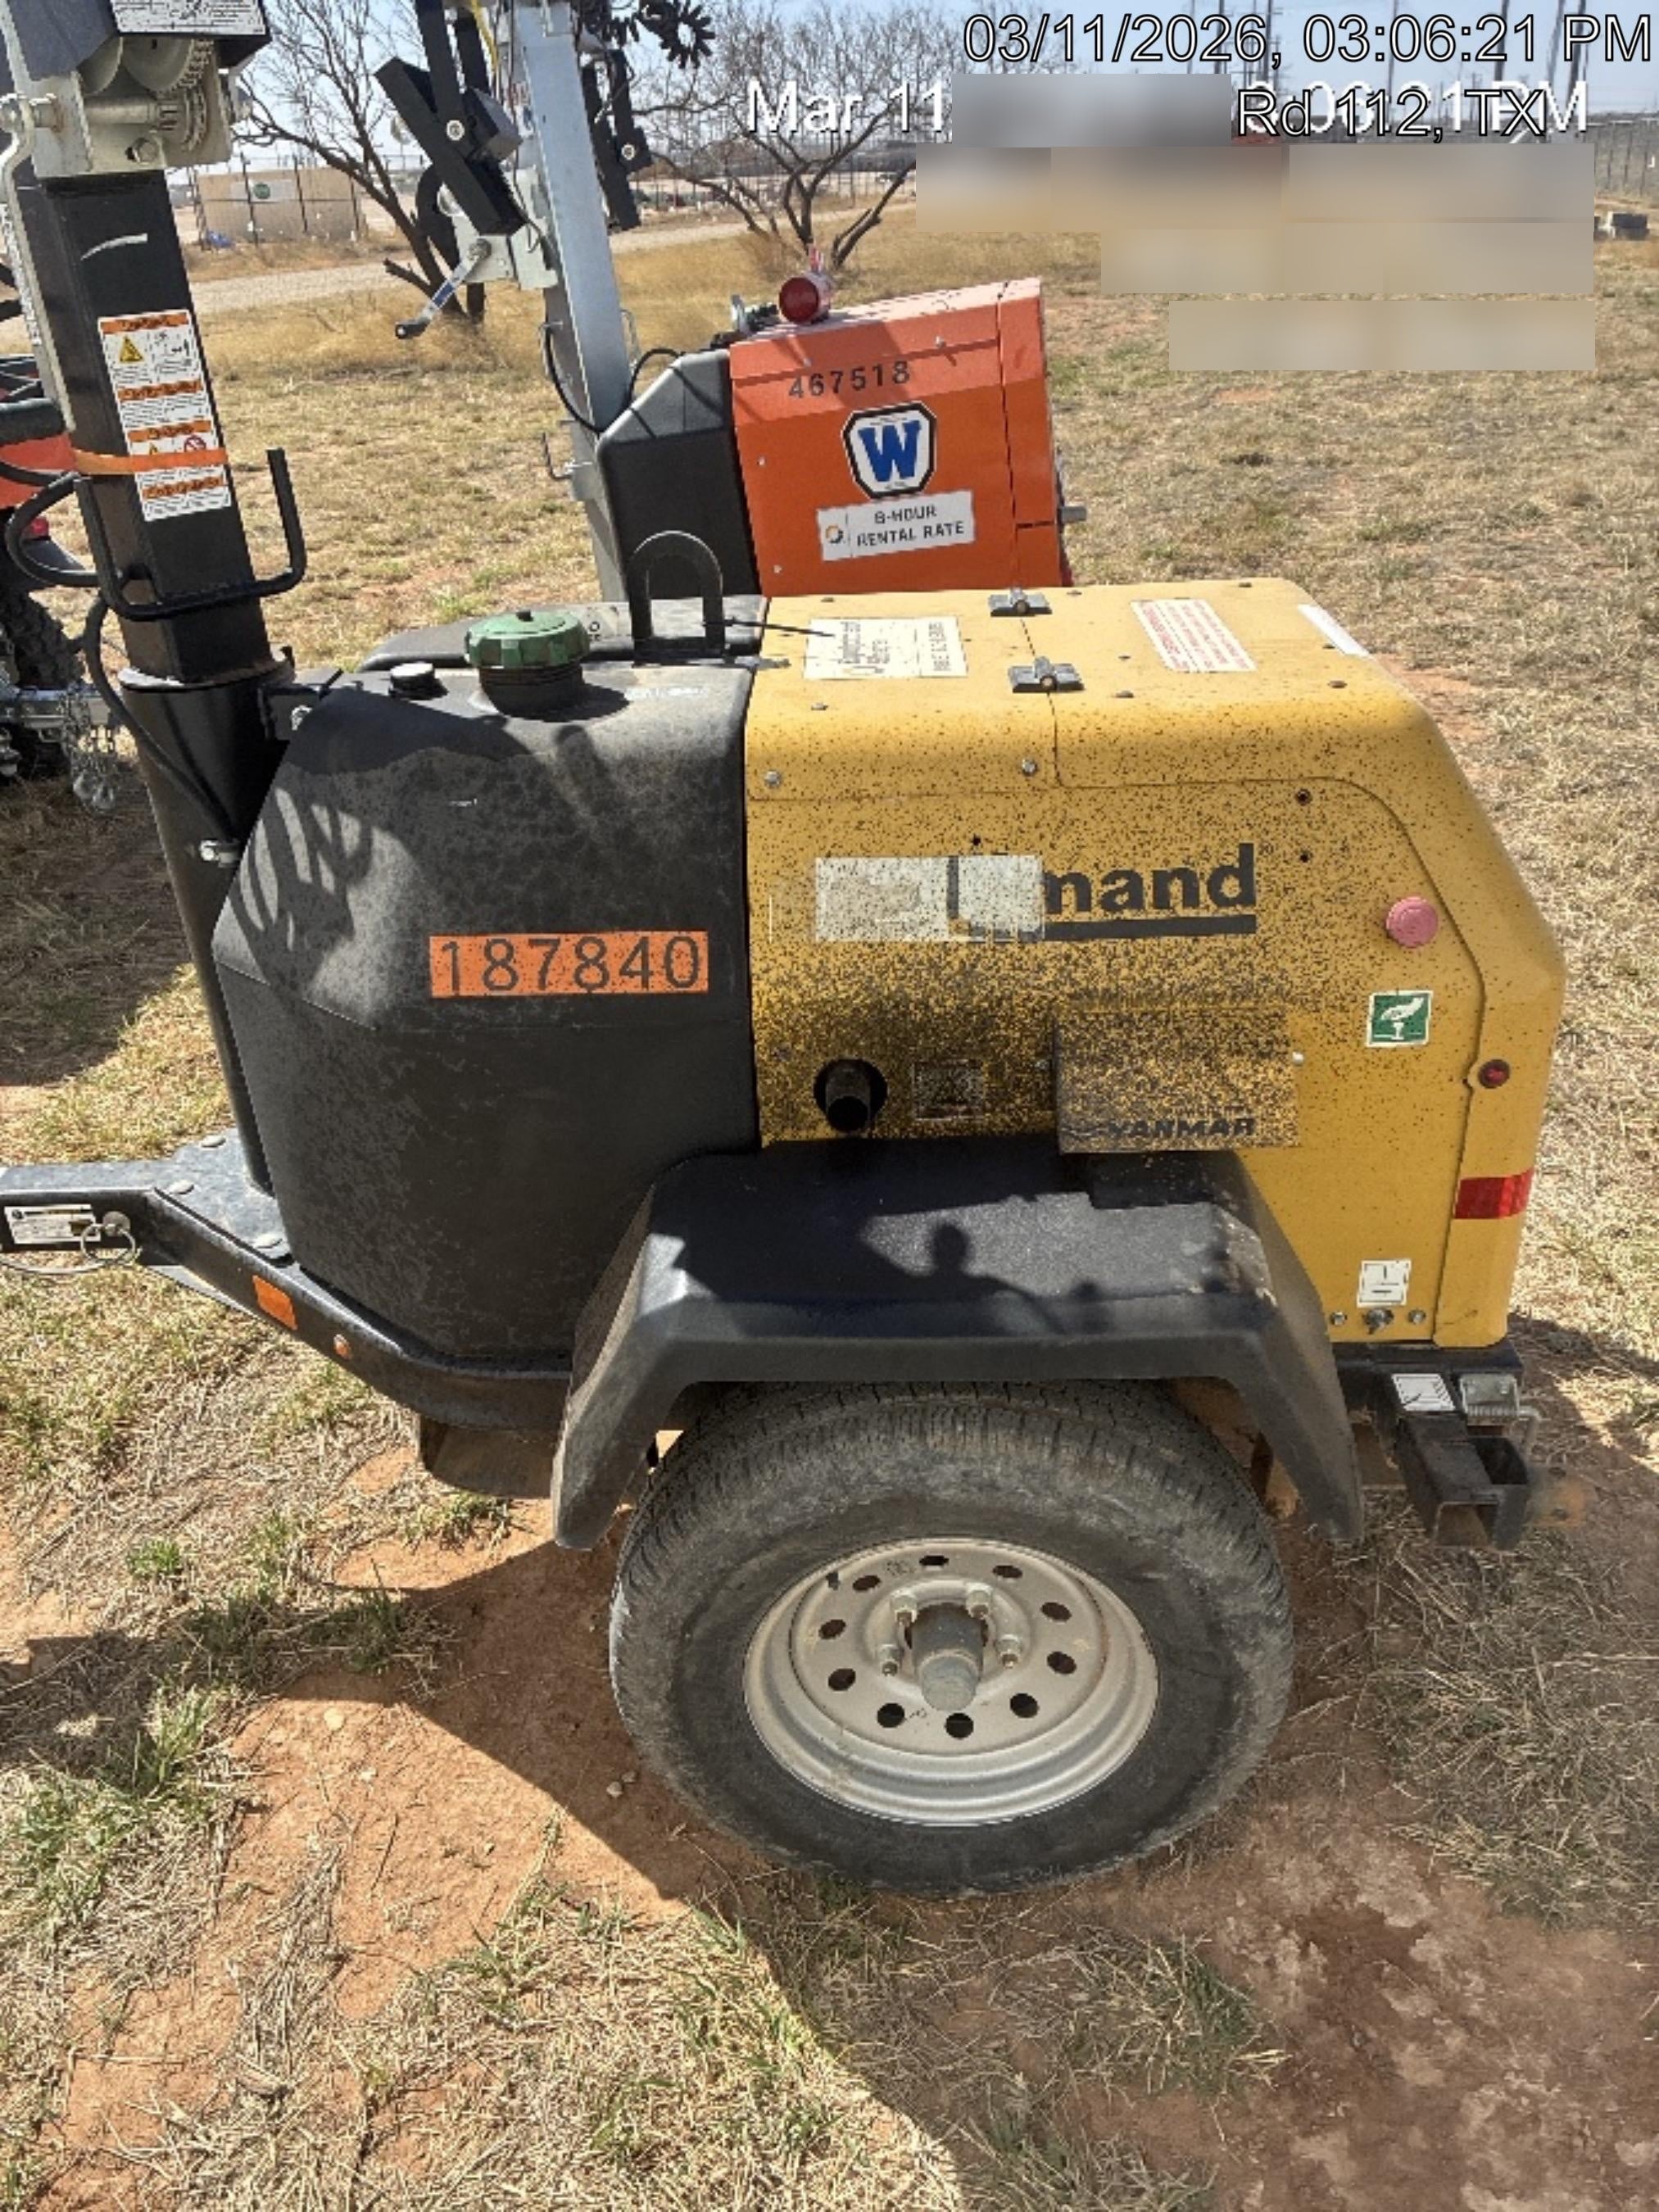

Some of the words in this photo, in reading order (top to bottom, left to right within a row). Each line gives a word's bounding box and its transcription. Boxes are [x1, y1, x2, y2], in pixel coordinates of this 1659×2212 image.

[788, 360, 910, 399] 467518
[857, 419, 922, 483] W
[856, 527, 917, 547] RENTAL
[922, 520, 964, 539] RATE
[441, 936, 699, 992] 187840
